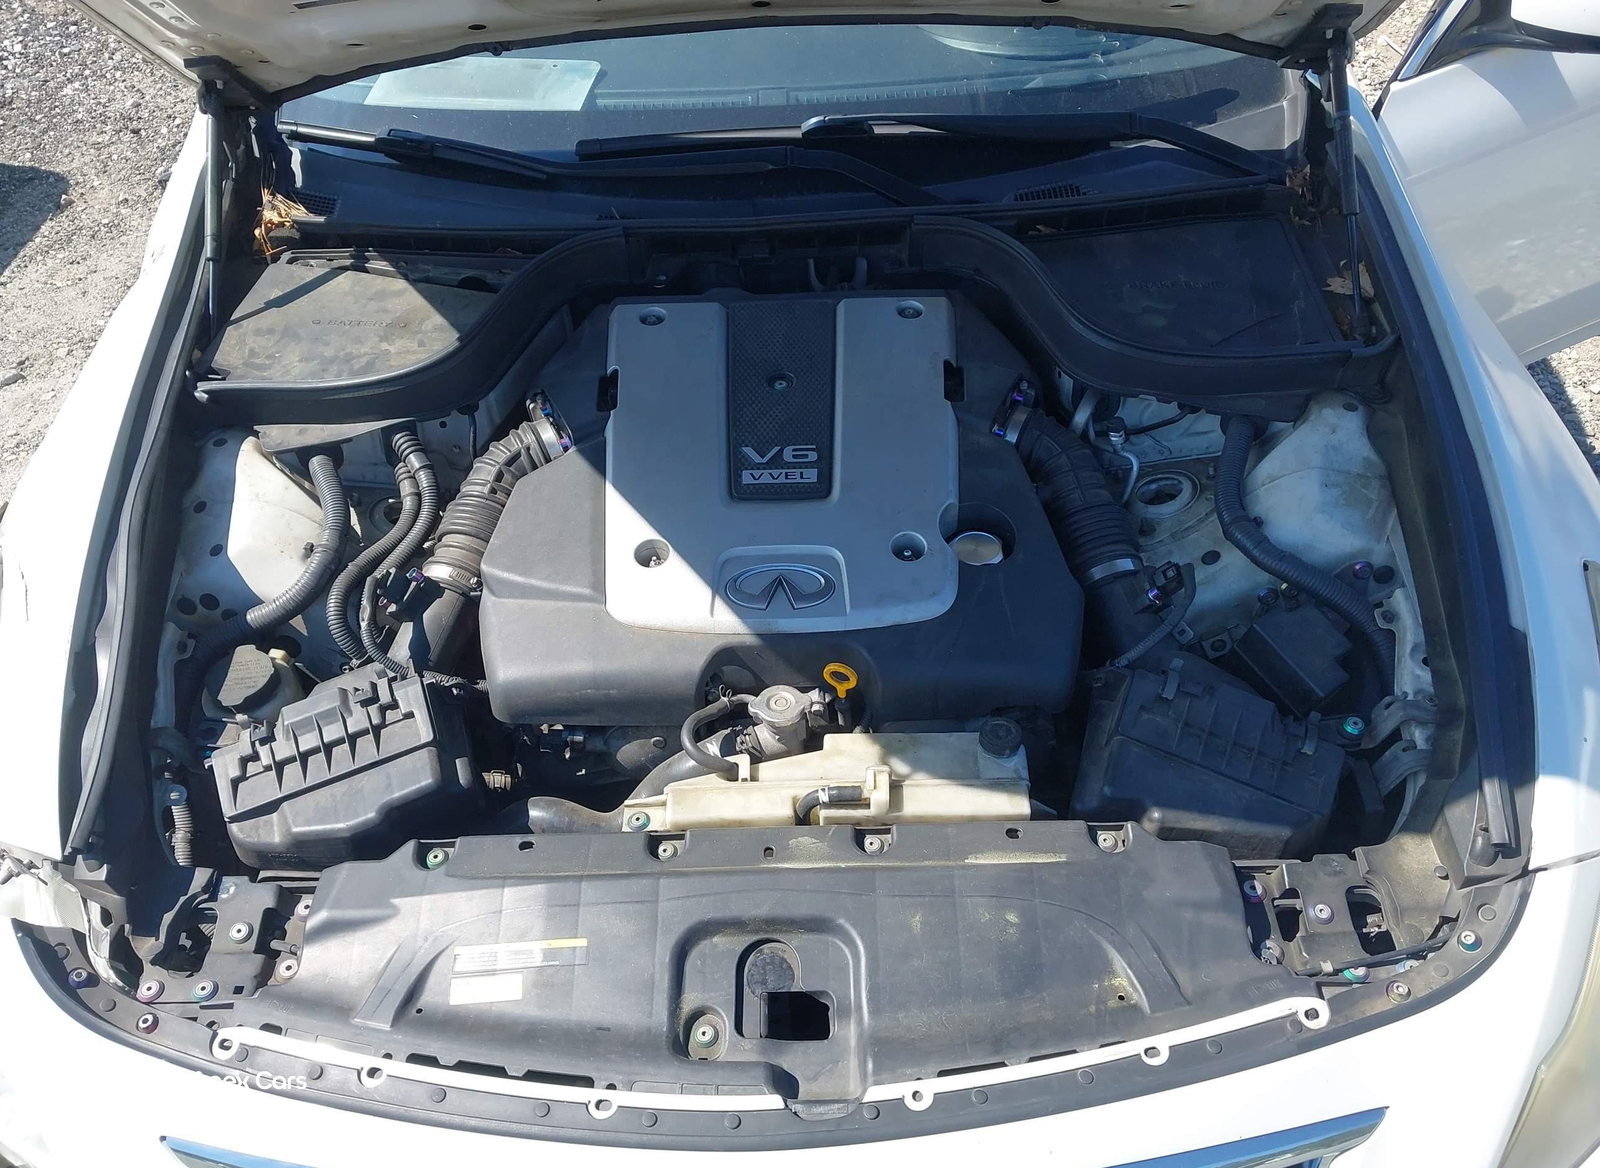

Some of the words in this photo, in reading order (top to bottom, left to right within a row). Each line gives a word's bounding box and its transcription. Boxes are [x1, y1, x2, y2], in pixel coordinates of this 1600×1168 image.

[1127, 281, 1178, 289] BRAKE
[327, 318, 394, 327] BATTERY
[741, 445, 818, 463] V6
[749, 471, 811, 481] VVEL
